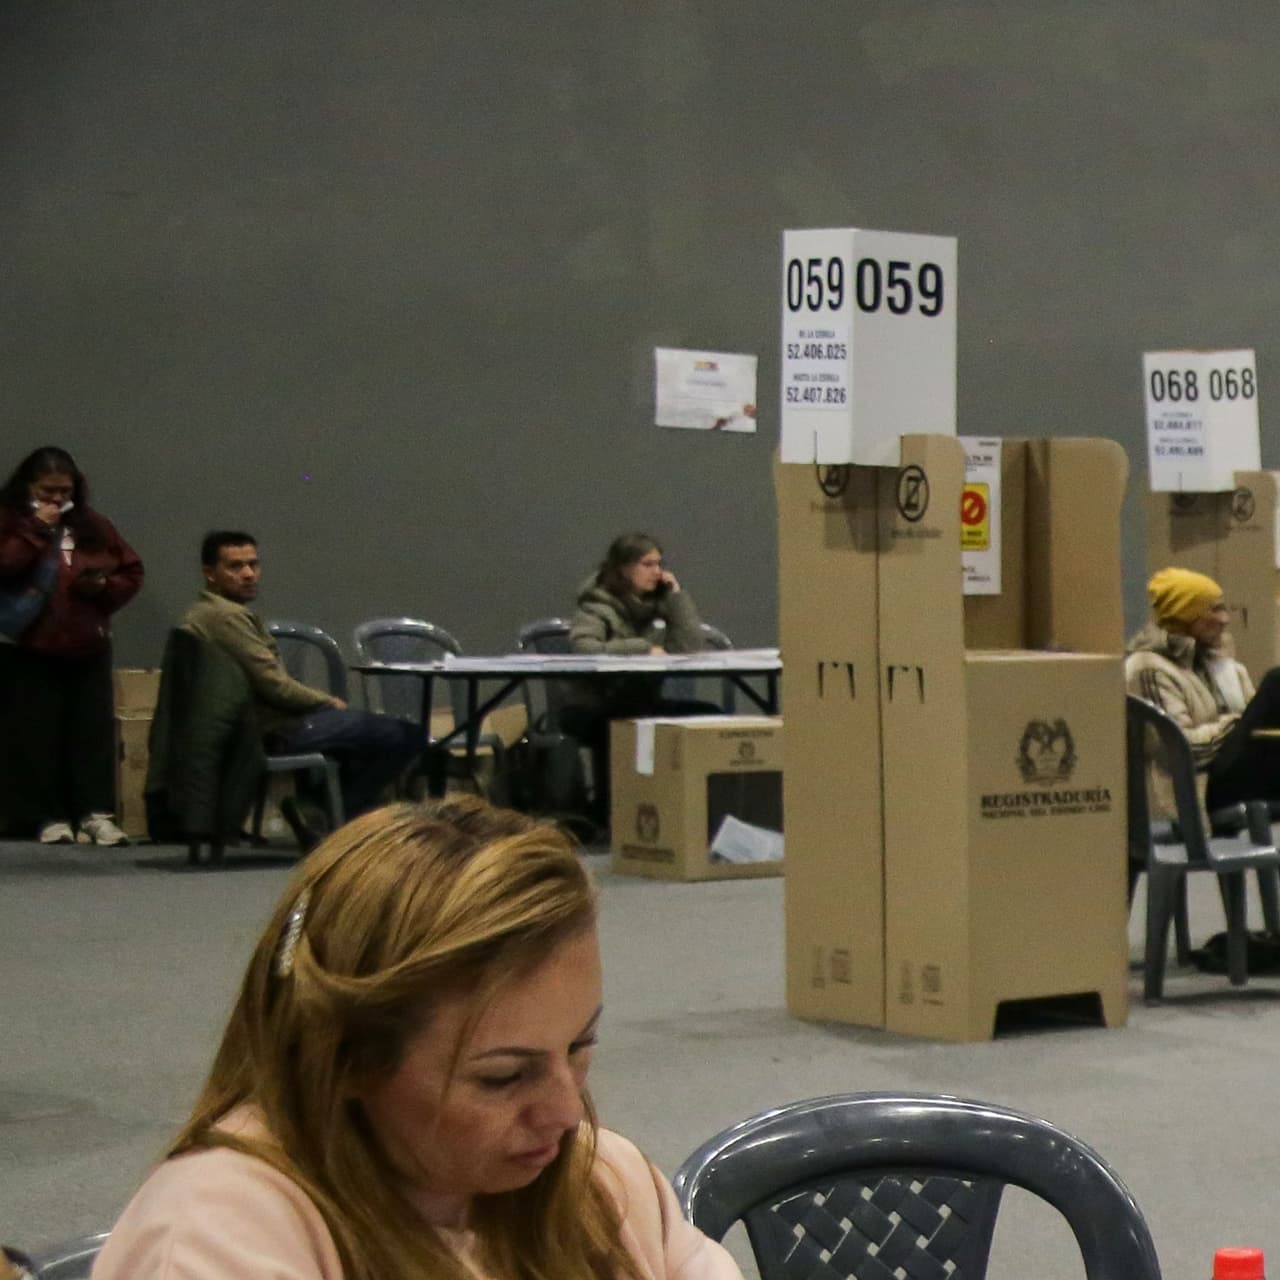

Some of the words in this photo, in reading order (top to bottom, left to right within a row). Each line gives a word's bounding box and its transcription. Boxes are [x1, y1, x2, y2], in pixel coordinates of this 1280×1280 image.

[787, 256, 844, 312] 059
[856, 257, 944, 318] 059
[1151, 370, 1199, 402] 068
[1210, 368, 1255, 402] 068
